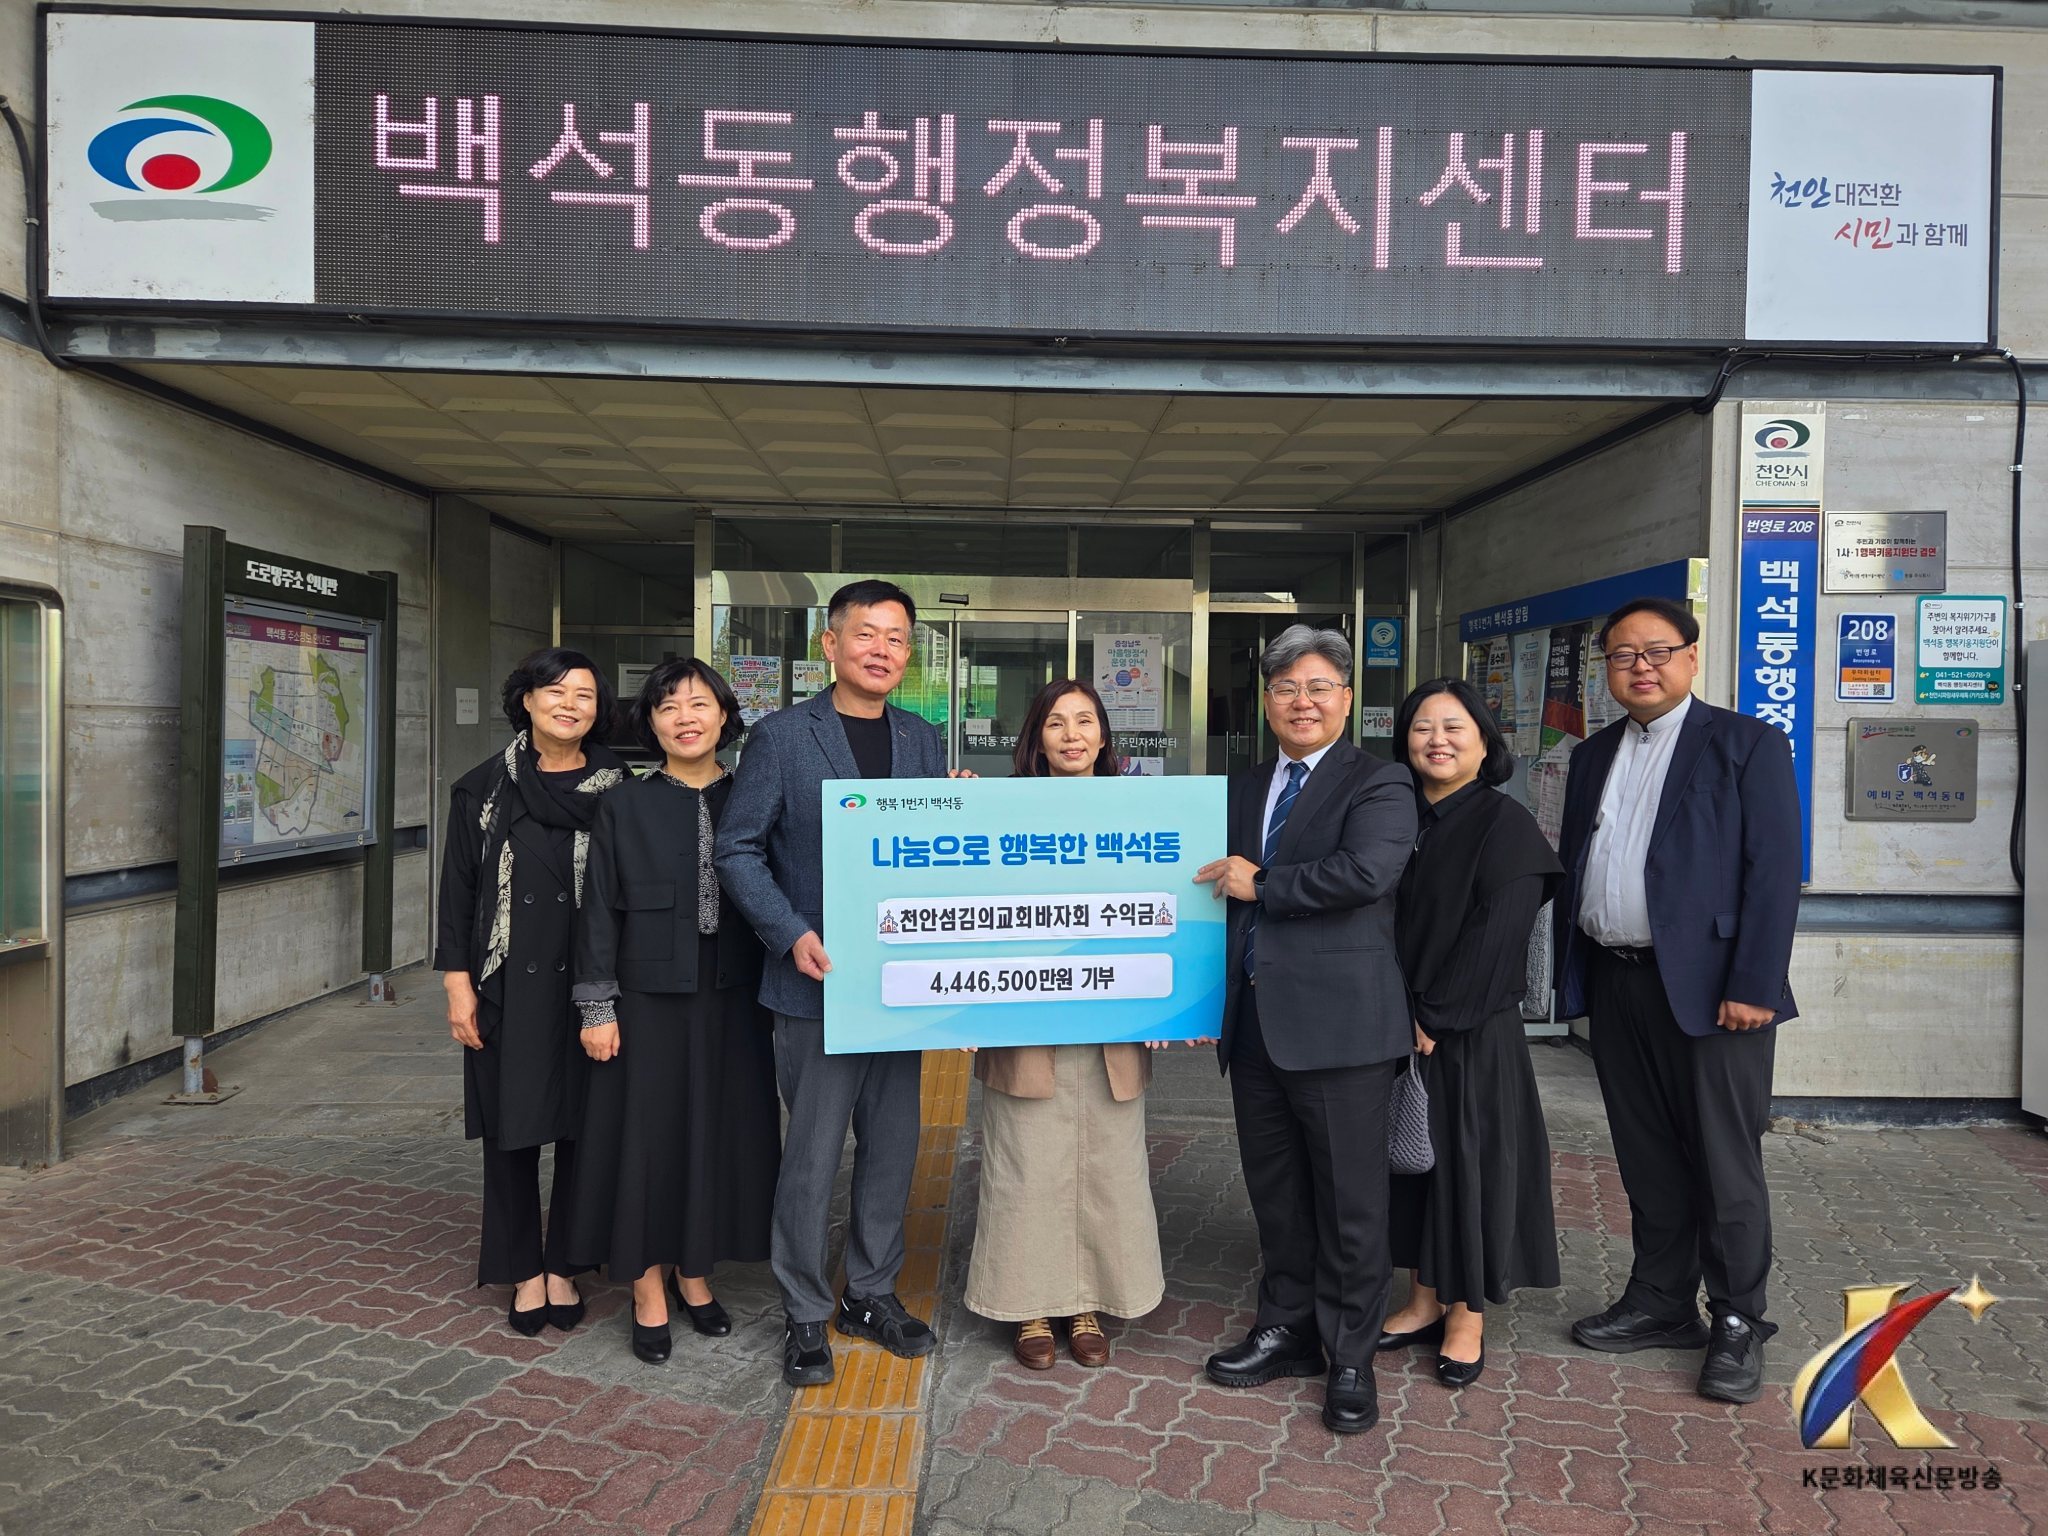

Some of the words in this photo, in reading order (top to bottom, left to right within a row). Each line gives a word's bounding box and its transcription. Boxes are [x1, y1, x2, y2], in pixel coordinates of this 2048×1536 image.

[371, 93, 1687, 273] 백석동행정복지센터
[1770, 172, 1831, 208] 천안
[1835, 183, 1902, 206] 대전환
[1834, 217, 1918, 249] 시민과
[1924, 222, 1968, 247] 함께
[1755, 464, 1809, 480] 천안시
[1746, 519, 1785, 533] 번영로
[1787, 520, 1814, 533] 208
[1920, 547, 1937, 557] 결연
[246, 560, 304, 589] 도로명주소
[306, 573, 338, 597] 안내판
[1494, 609, 1513, 627] 백석동
[1515, 605, 1529, 623] 알림
[1927, 612, 1948, 622] 주변의
[1949, 612, 1996, 622] 복지위기가구를
[266, 627, 287, 640] 백석동
[288, 630, 312, 643] 주소정보
[1848, 620, 1888, 640] 208
[1932, 626, 1953, 635] 찾아서
[1115, 640, 1141, 648] 충청남도
[1923, 638, 1943, 648] 백석동
[1945, 638, 1999, 648] 행복키움지원단이
[1108, 648, 1148, 658] 마을행정사
[1943, 652, 1979, 661] 함께합니다.
[1111, 659, 1127, 667] 운영
[1129, 659, 1145, 667] 안내
[1754, 560, 1799, 763] 백석동행정
[803, 671, 824, 682] 109
[1372, 716, 1393, 728] 109
[968, 735, 997, 747] 백석동
[1119, 737, 1177, 748] 주민자치센터
[1867, 790, 1905, 801] 예비군
[1913, 791, 1965, 801] 백석동대
[930, 796, 964, 811] 백석동
[872, 835, 991, 868] 나눔으로
[999, 833, 1088, 865] 행복한
[1096, 831, 1181, 863] 백석동
[899, 903, 1090, 933] 천안섬김의교회바자회
[1099, 902, 1155, 927] 수익금
[929, 966, 1073, 994] 4,446,500만원
[1080, 966, 1115, 991] 기부
